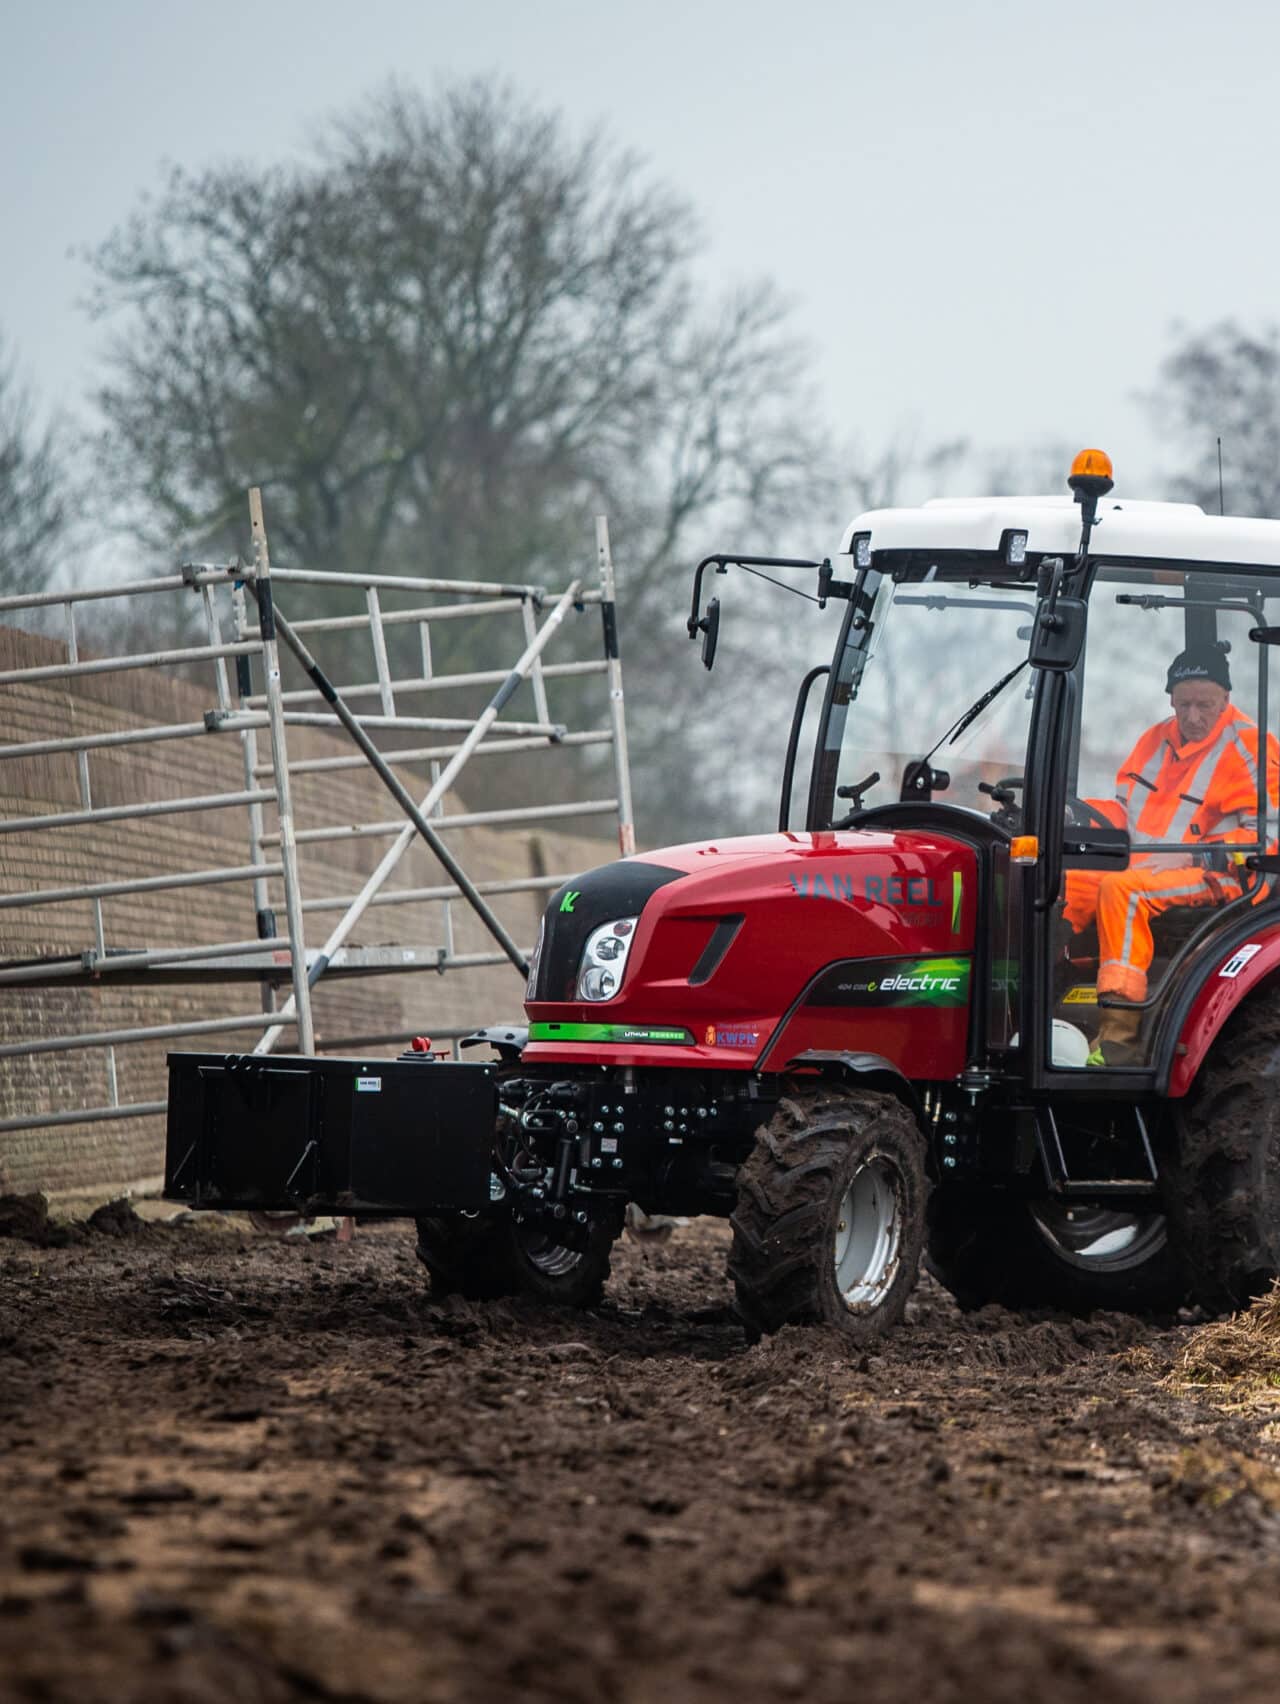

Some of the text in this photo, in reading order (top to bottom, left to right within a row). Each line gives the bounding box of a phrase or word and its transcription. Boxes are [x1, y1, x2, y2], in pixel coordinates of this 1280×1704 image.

[789, 873, 943, 906] VAN REEL
[880, 974, 960, 991] electric
